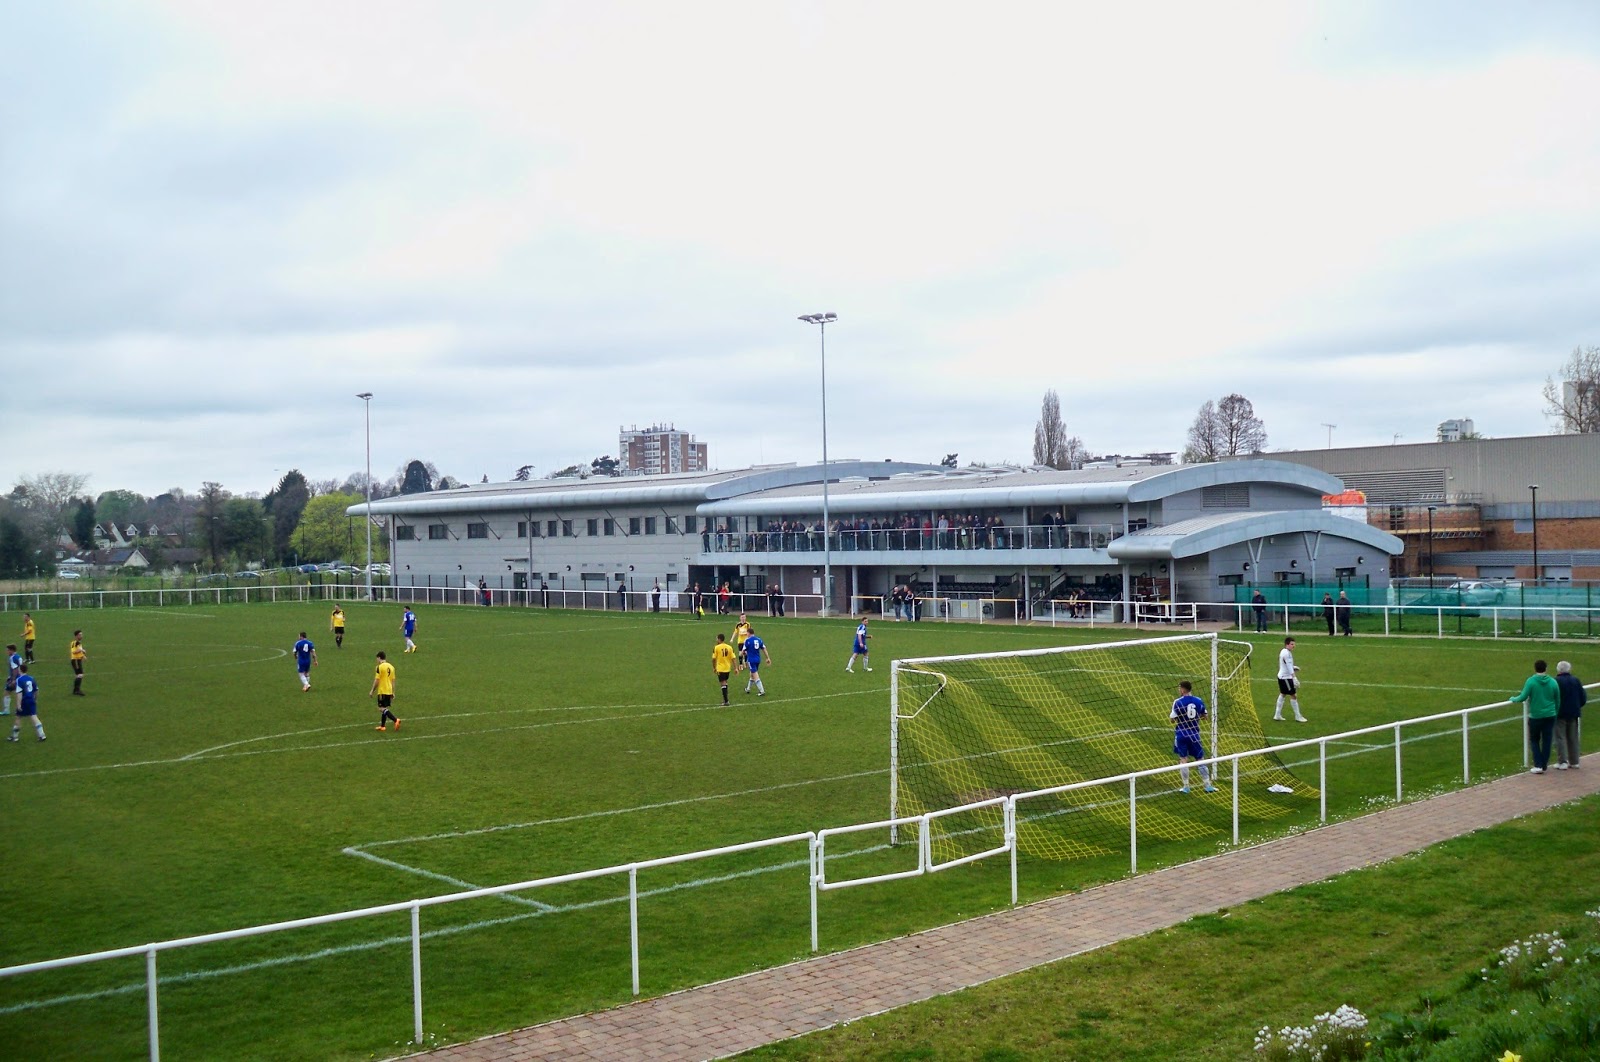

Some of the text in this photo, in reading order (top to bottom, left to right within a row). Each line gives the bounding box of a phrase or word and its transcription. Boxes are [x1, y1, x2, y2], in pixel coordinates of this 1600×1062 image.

[303, 643, 309, 652] 4
[754, 640, 760, 649] 5
[387, 667, 391, 677] 9
[26, 681, 33, 692] 3
[1187, 703, 1196, 719] 6
